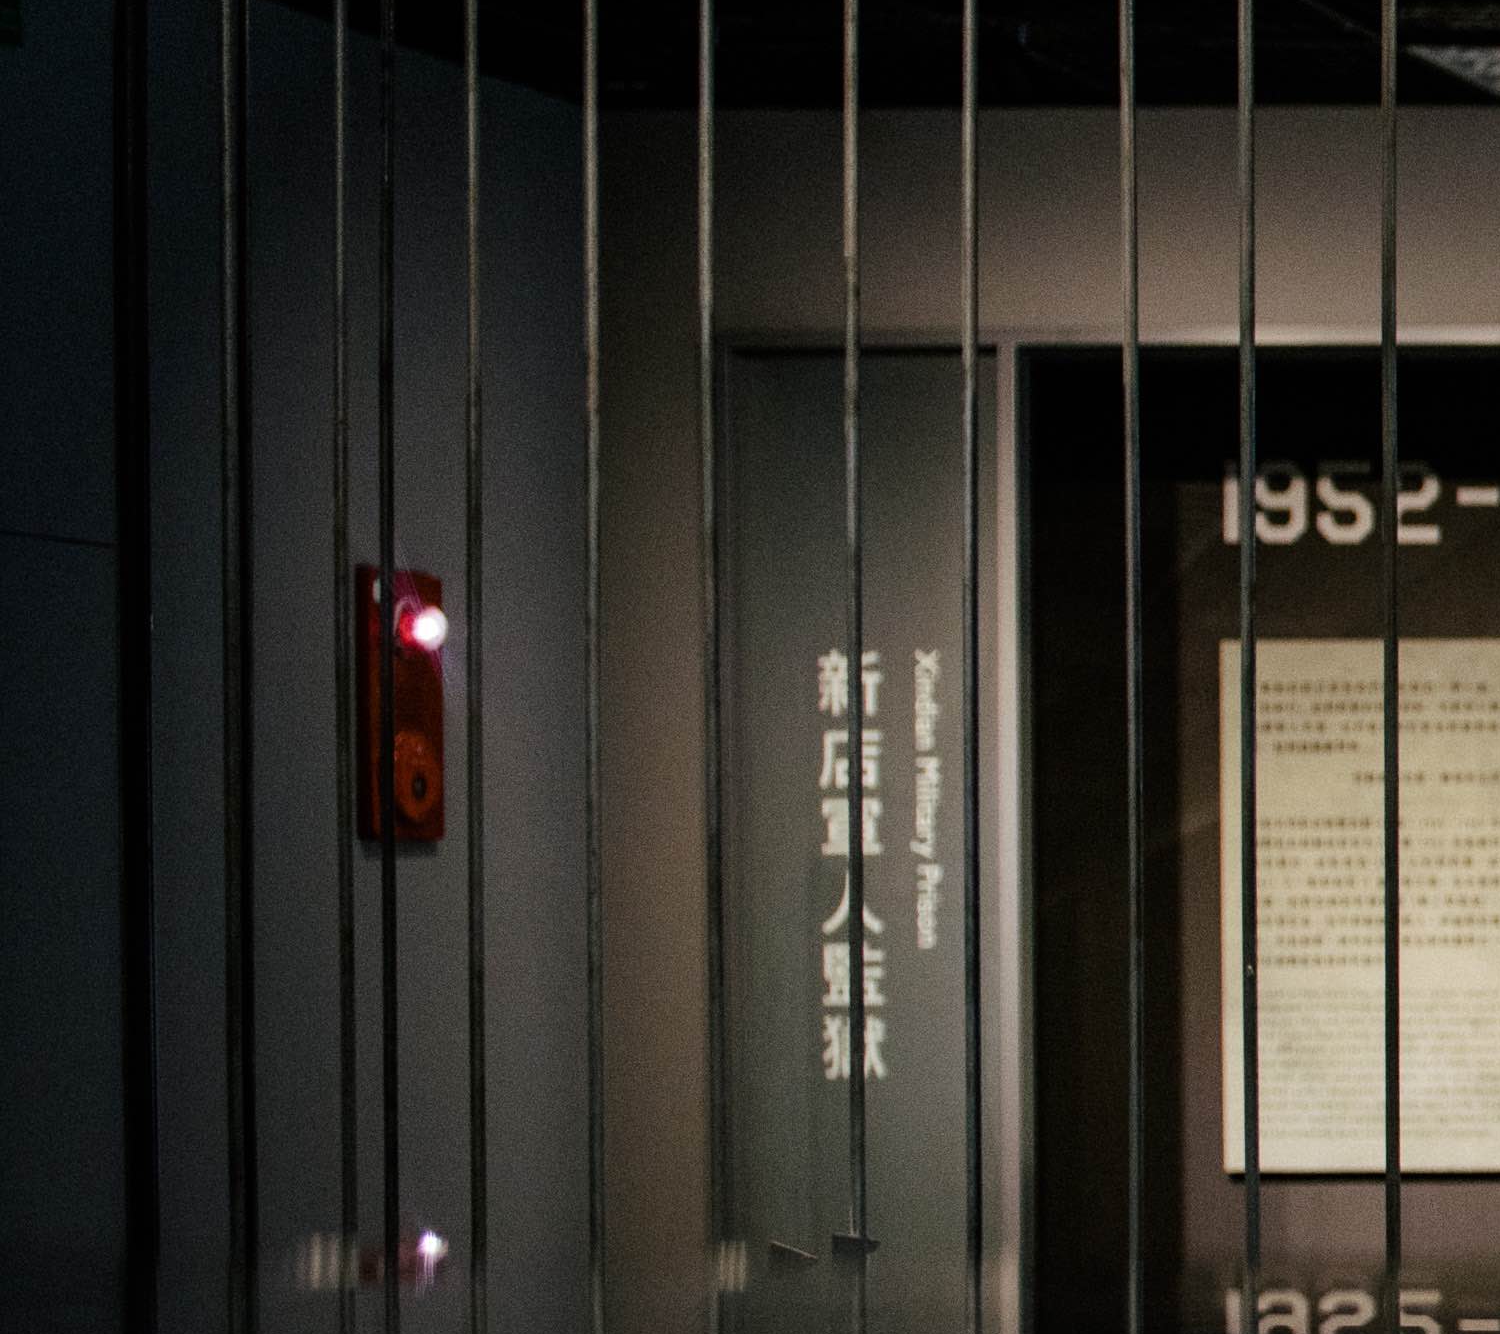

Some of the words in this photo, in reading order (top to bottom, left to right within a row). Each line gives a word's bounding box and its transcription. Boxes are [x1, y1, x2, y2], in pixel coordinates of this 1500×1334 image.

[817, 647, 886, 1081] 新店軍人監獄
